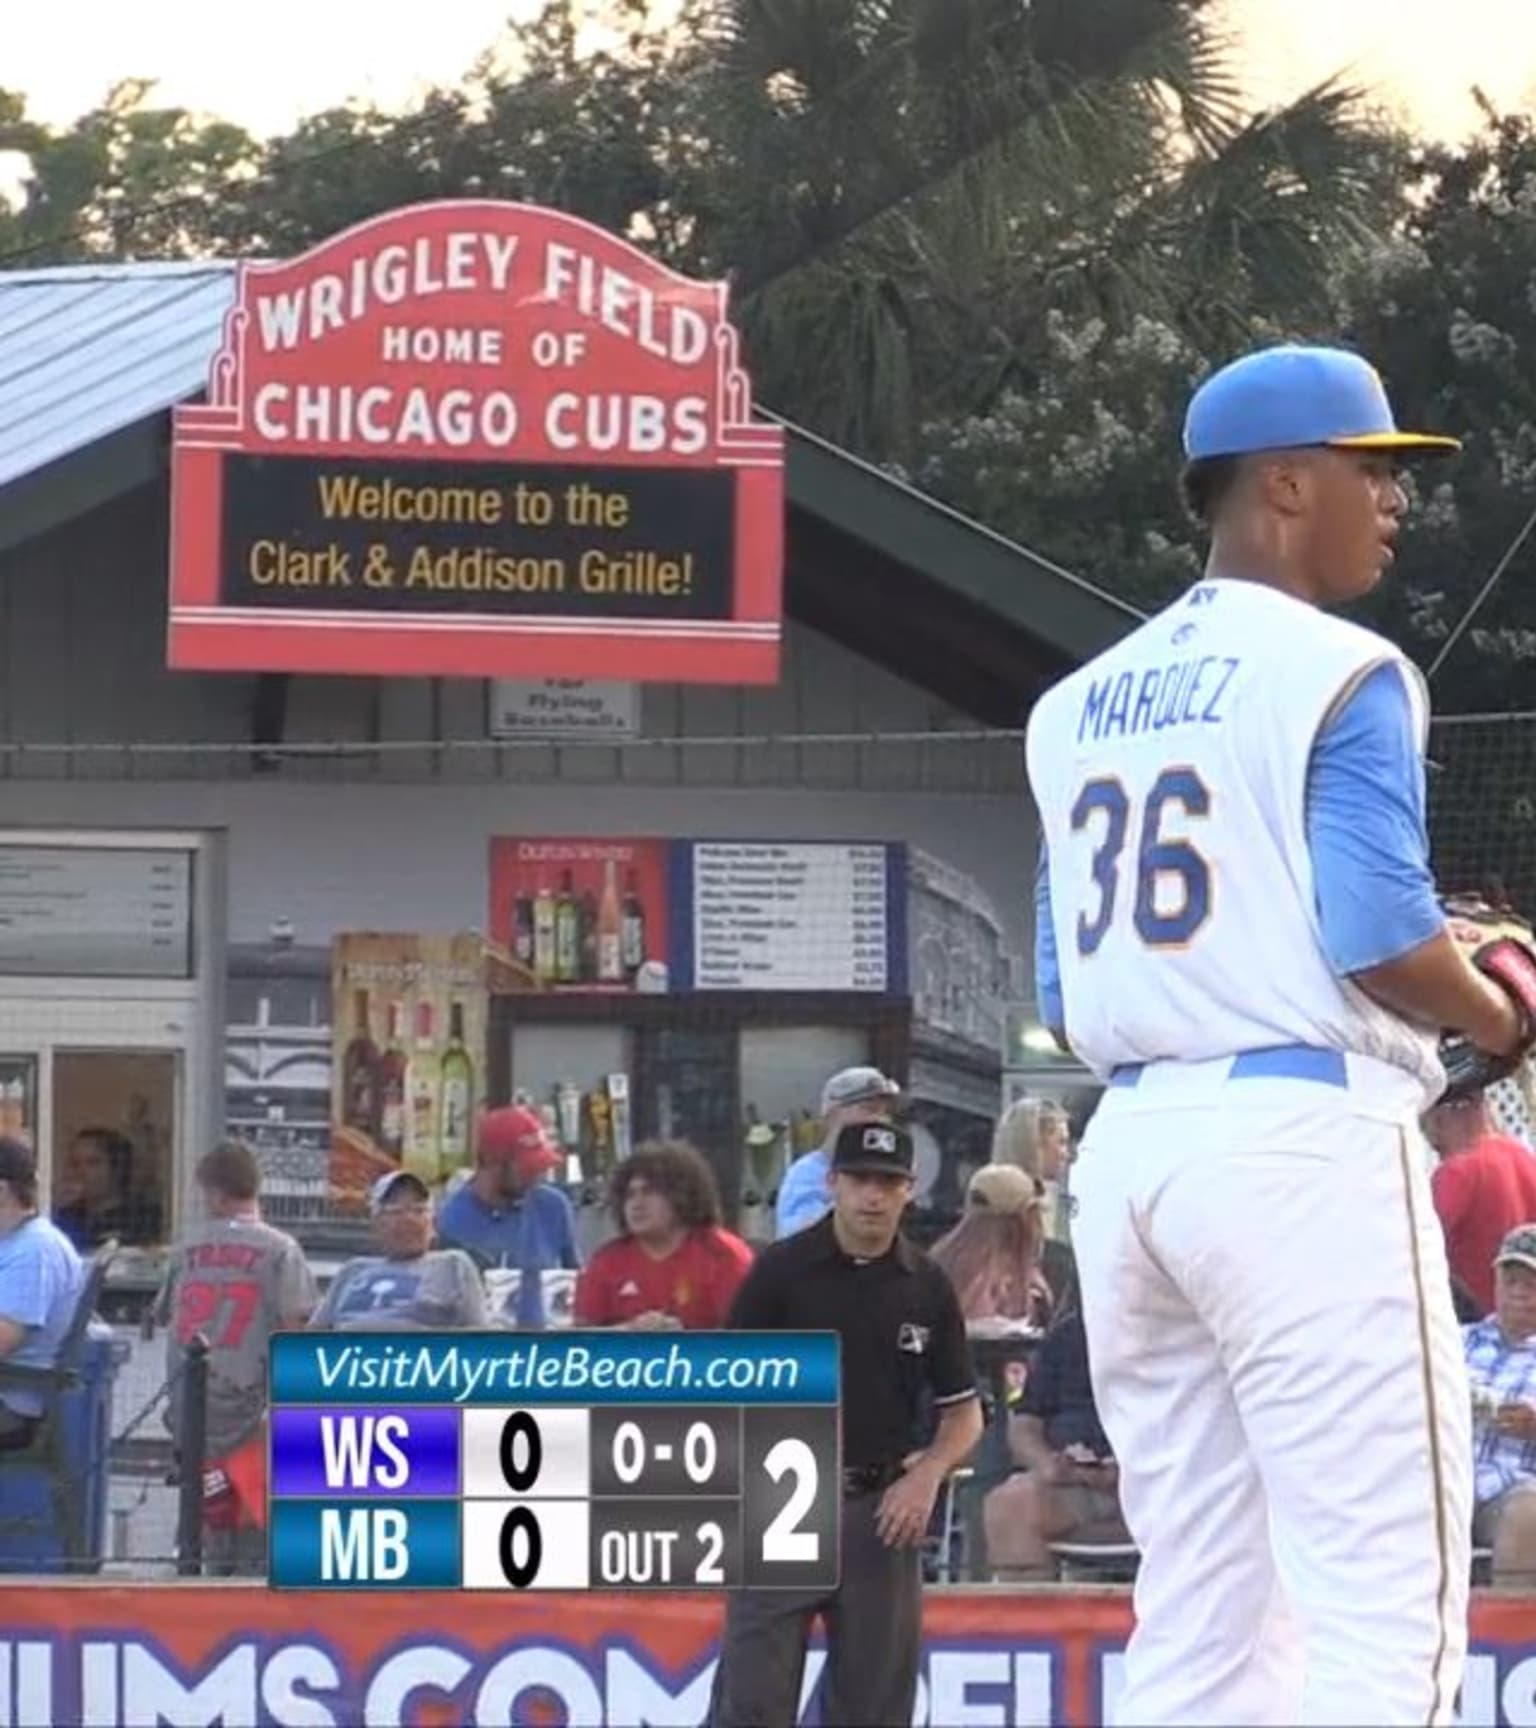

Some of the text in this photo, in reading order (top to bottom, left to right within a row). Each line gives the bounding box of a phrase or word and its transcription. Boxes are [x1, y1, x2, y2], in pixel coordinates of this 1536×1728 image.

[257, 232, 709, 365] WRIGLEY FIELD
[382, 327, 588, 368] HOME OF
[253, 383, 709, 455] CHICAGO CUBS
[318, 474, 630, 528] Welcome to the
[248, 540, 693, 596] Clark & Addison Grille!
[1076, 654, 1241, 744] MARQUEZ
[1069, 763, 1212, 958] 36
